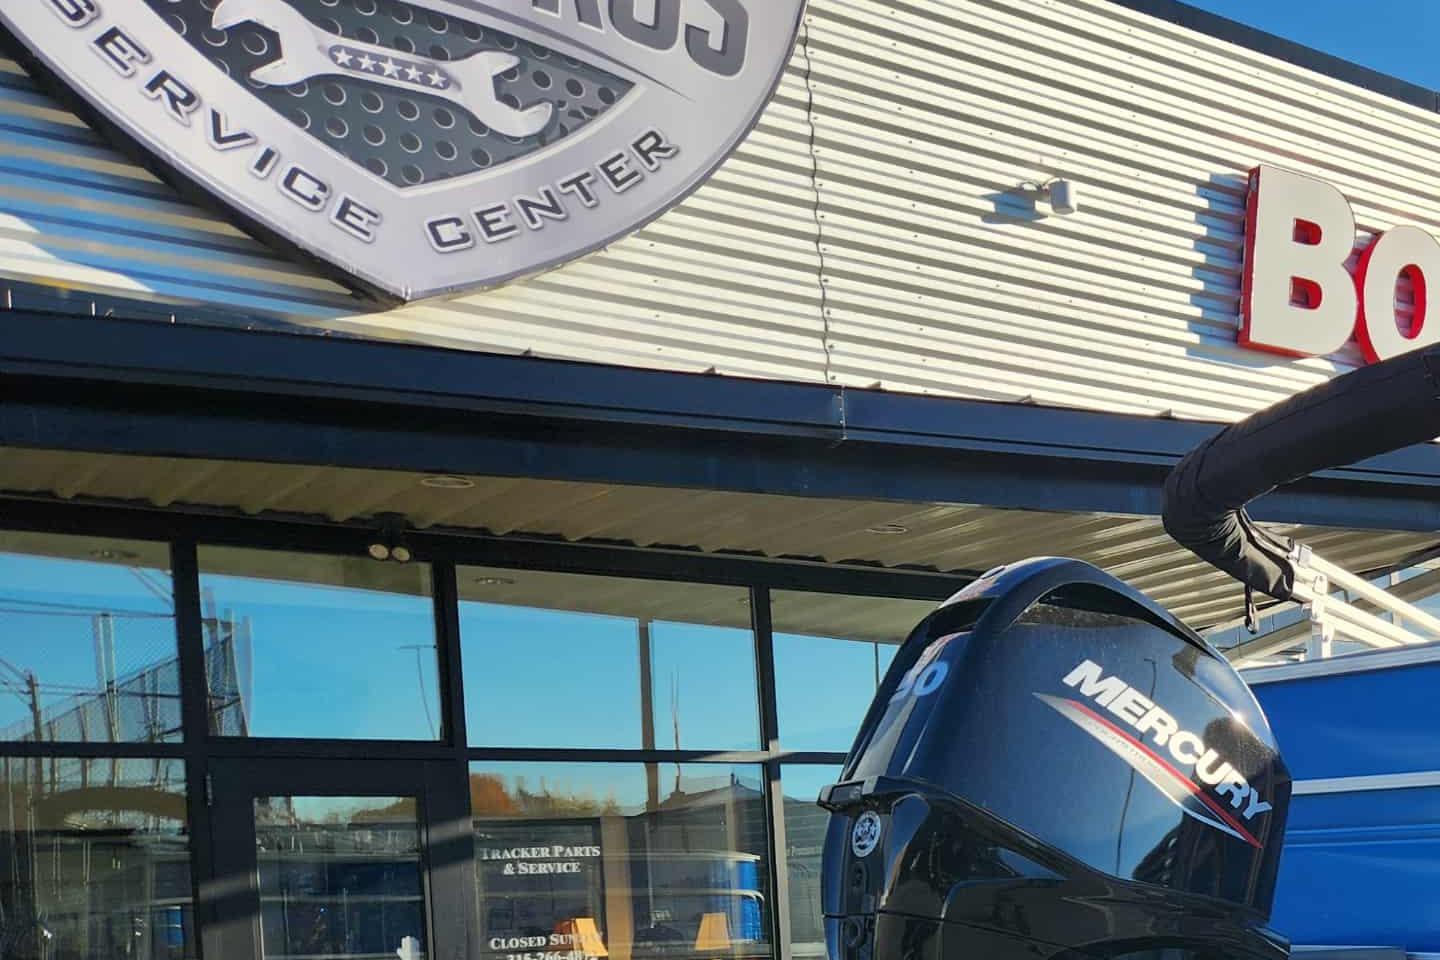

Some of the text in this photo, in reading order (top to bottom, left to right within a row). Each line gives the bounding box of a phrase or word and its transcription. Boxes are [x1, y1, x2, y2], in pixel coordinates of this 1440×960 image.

[429, 130, 680, 251] CENTER
[1062, 659, 1272, 821] MERCURY
[481, 845, 601, 860] TRACKER PARTS
[504, 862, 581, 875] & SERVICE
[489, 937, 546, 950] CLOSED
